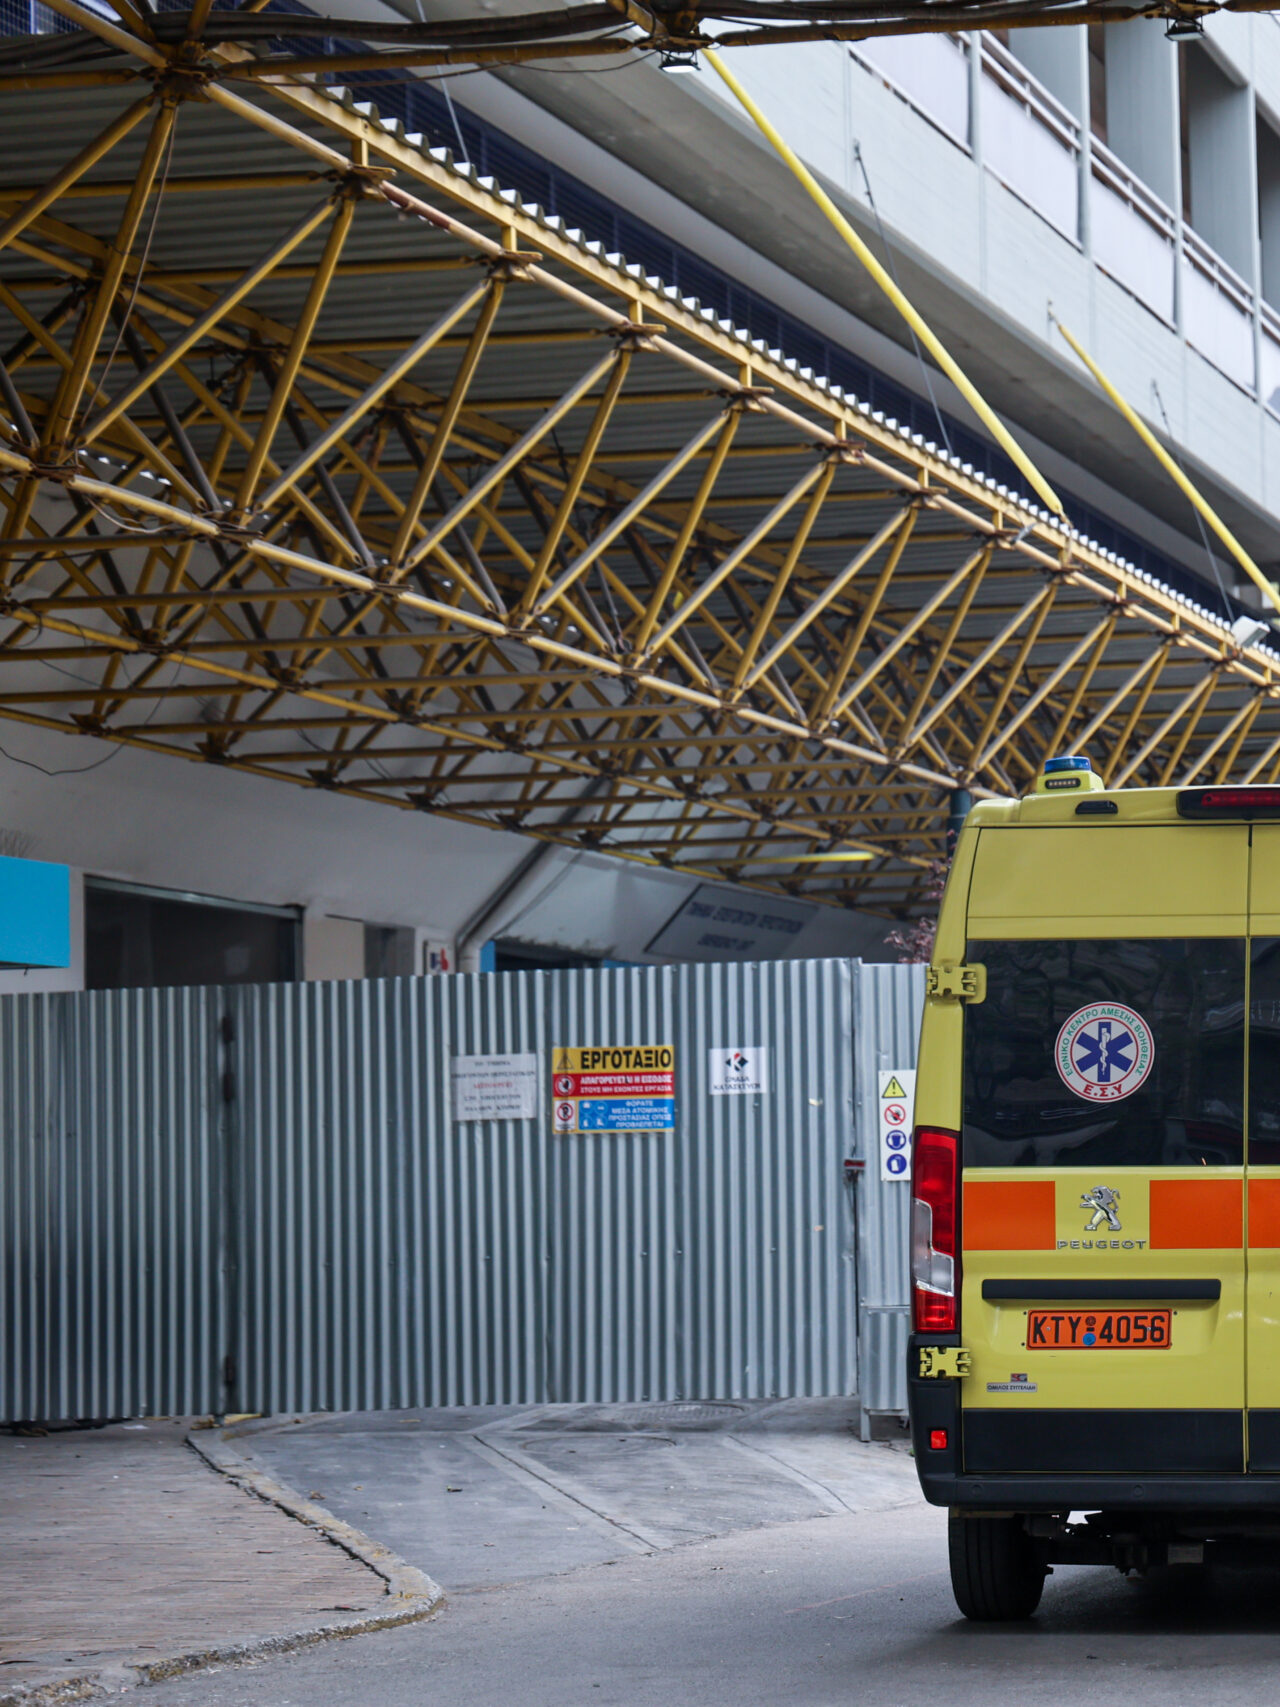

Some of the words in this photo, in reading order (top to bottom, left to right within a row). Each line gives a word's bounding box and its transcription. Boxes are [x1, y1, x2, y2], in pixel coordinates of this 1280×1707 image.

[1067, 1008, 1098, 1037] ΚΕΝΤΡΟ
[1100, 1007, 1136, 1027] ΑΜΕΣΗΣ
[581, 1049, 672, 1070] ΕΡΓΟΤΑΞΙΟ
[1061, 1037, 1074, 1077] ΕΘΝΙΚΟ
[1134, 1024, 1149, 1076] ΒΟΗΘΕΙΑΣ
[1083, 1084, 1122, 1097] Ε.Σ.Υ
[1057, 1239, 1147, 1250] PEUGEOT
